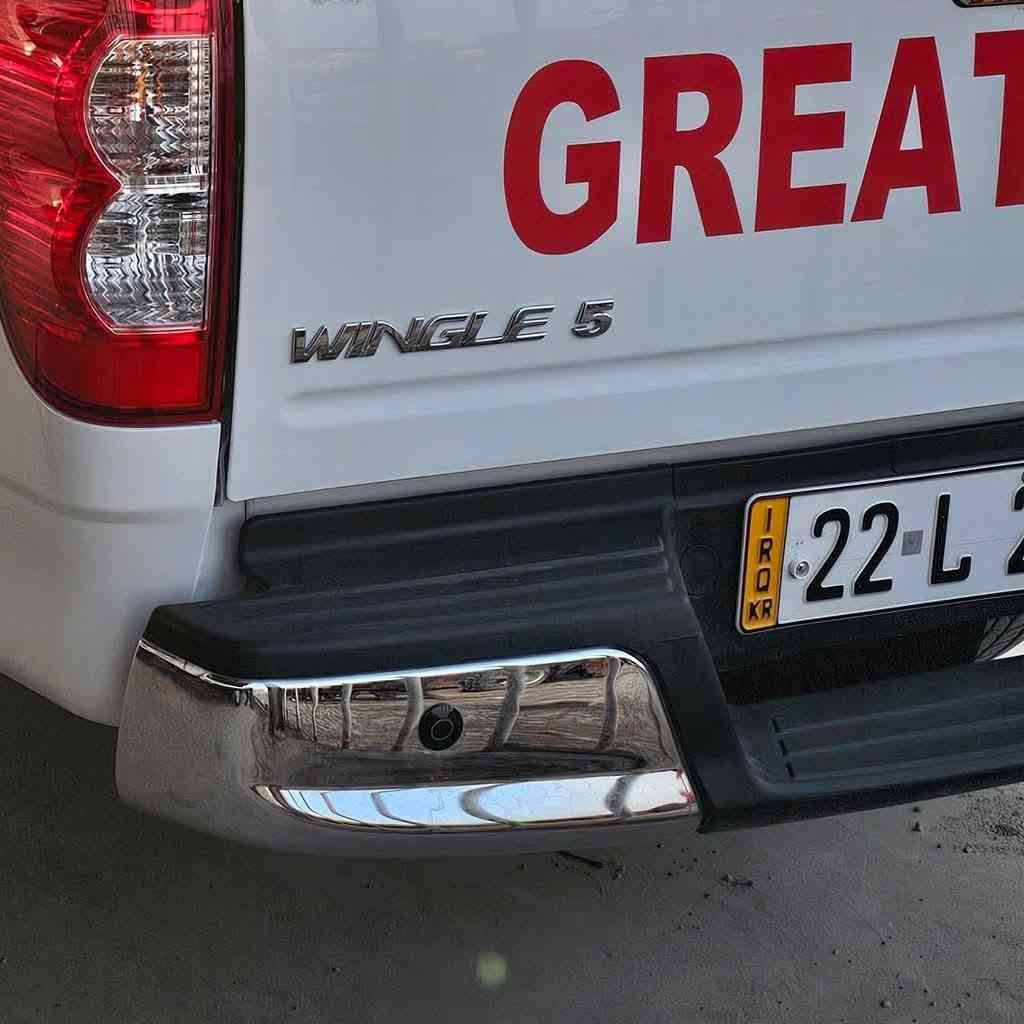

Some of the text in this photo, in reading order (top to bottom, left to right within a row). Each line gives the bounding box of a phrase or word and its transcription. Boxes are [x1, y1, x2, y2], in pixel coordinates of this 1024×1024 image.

[289, 298, 615, 364] WINGLE 5
[805, 501, 900, 603] 22
[929, 493, 973, 585] L
[747, 598, 774, 622] KR
